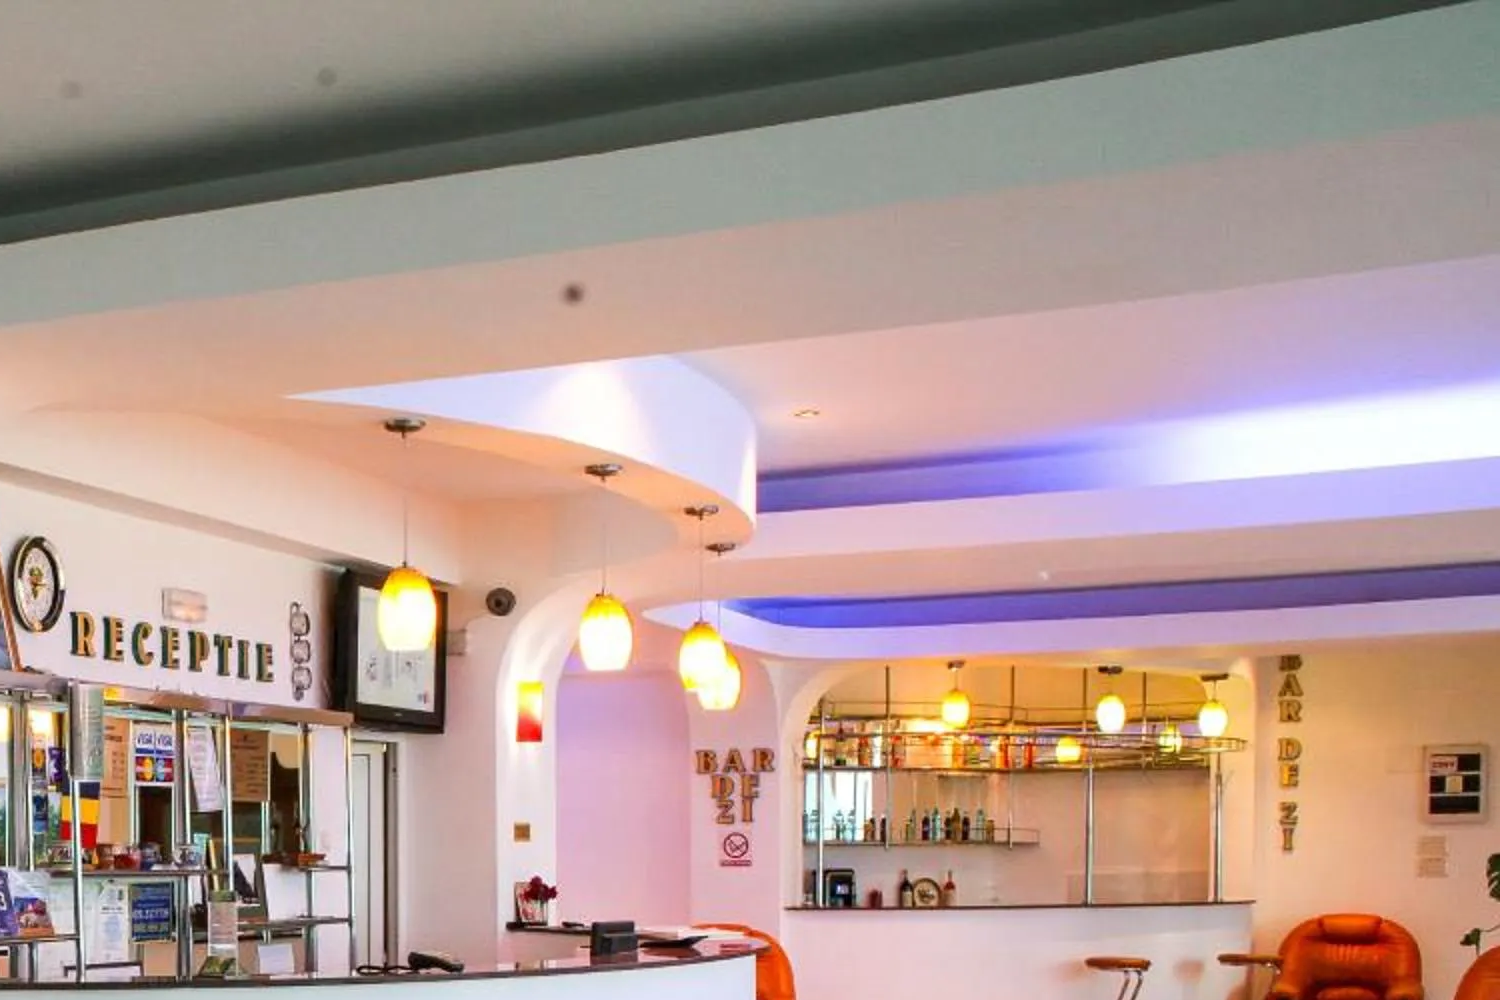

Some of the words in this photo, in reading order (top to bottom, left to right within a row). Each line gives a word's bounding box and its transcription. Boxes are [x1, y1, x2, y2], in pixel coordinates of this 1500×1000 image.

[70, 611, 274, 682] RECEPTIE
[137, 733, 153, 745] VISA
[158, 734, 173, 746] VISA
[695, 748, 775, 774] BAR
[1278, 738, 1303, 788] DE
[711, 773, 759, 798] DE
[716, 796, 753, 824] ZI
[1279, 801, 1299, 852] ZI
